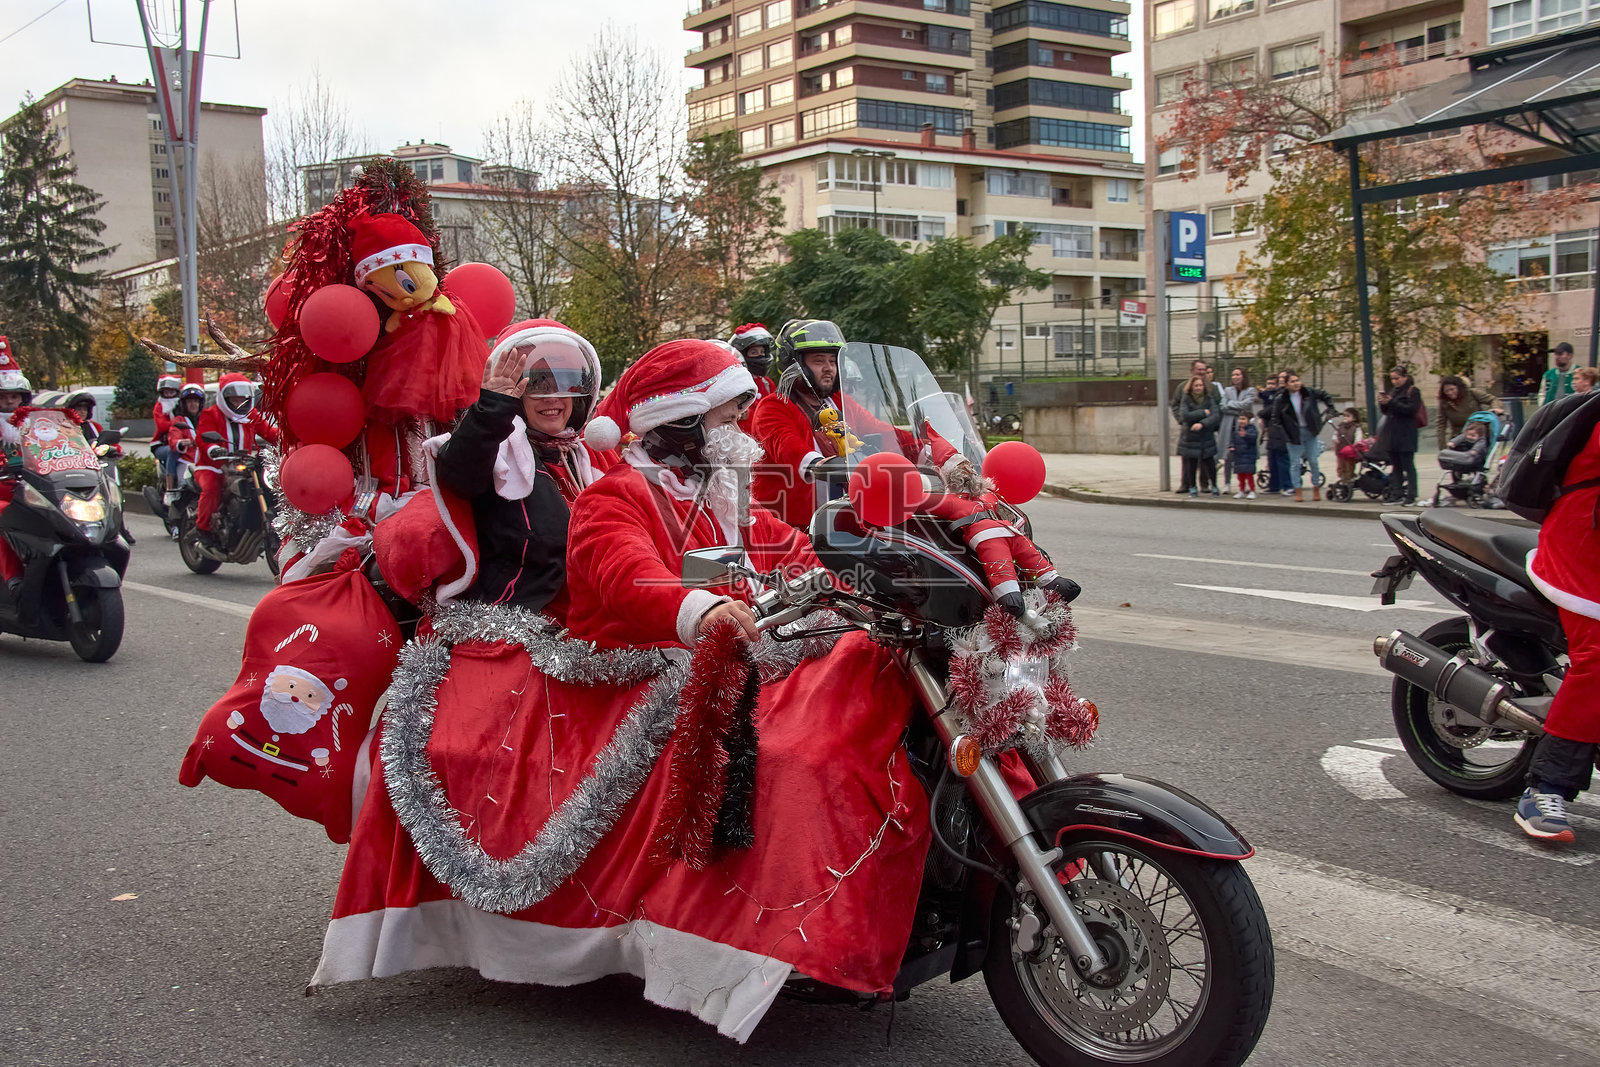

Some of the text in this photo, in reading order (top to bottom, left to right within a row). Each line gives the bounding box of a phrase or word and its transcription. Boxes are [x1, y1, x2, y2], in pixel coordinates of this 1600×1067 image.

[1179, 219, 1198, 252] P
[41, 443, 81, 461] Feliz
[38, 453, 100, 475] Navidad
